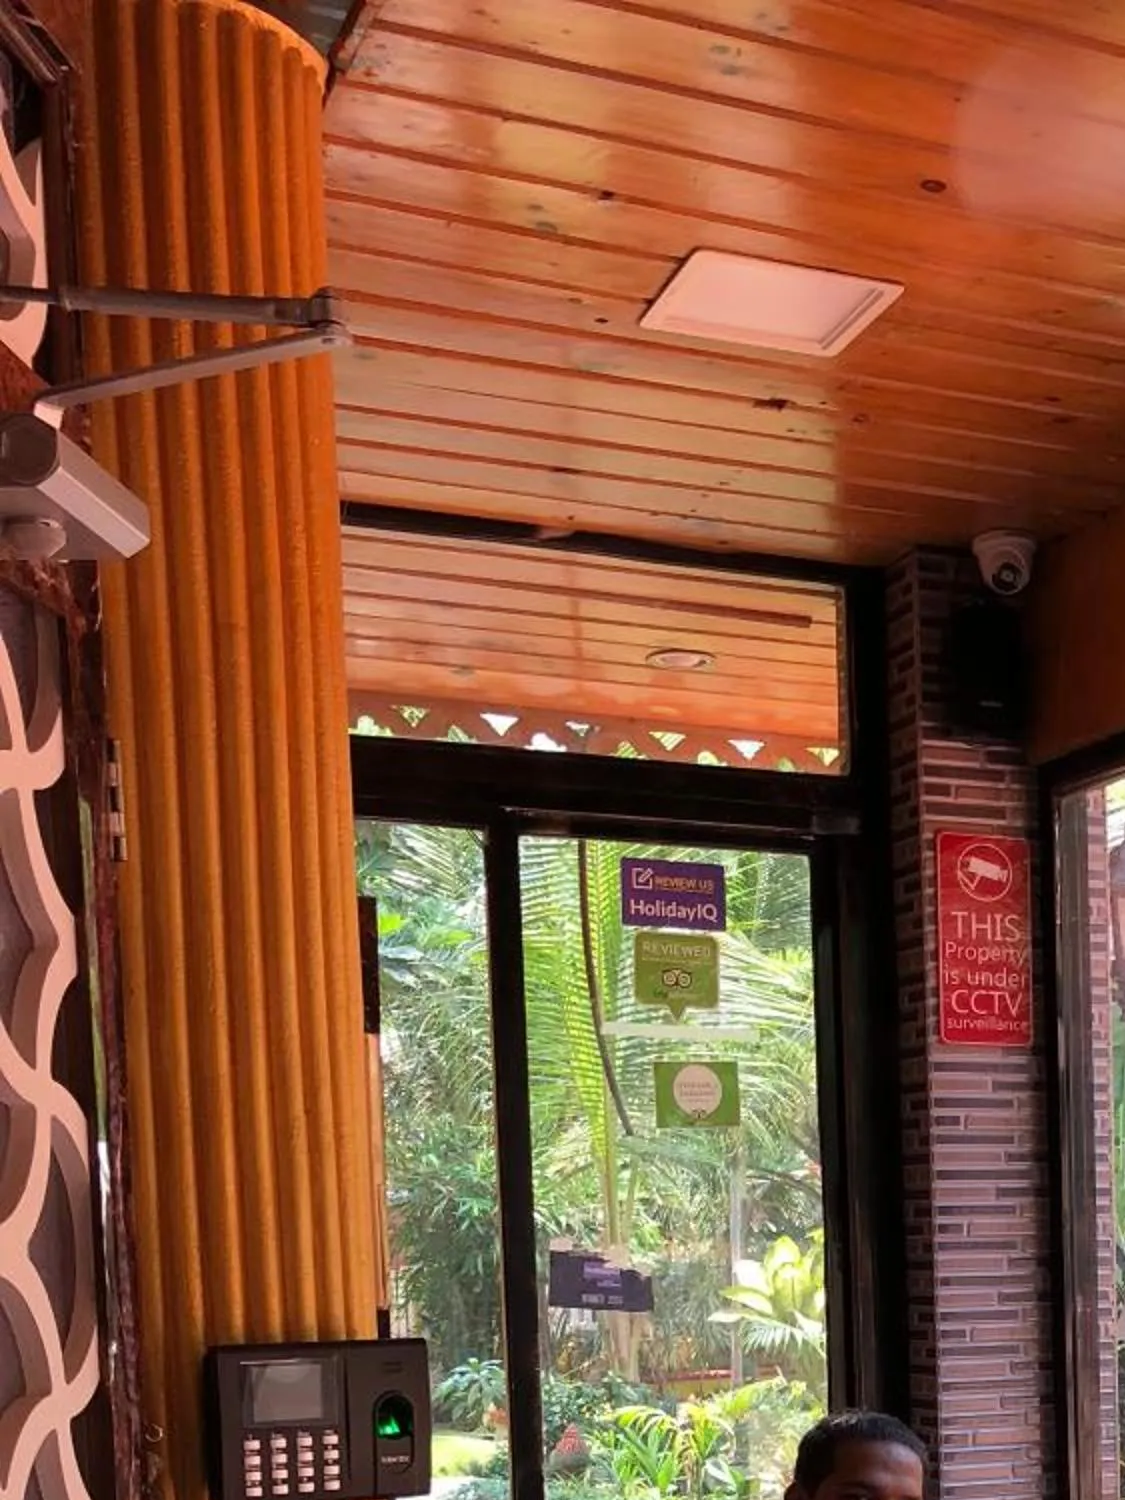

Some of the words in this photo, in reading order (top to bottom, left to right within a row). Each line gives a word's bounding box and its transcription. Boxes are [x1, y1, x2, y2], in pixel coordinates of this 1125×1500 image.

[654, 876, 697, 891] REVIEW
[630, 899, 718, 922] HolidayIQ
[951, 912, 1021, 941] THIS
[641, 940, 711, 958] REVIEWED
[945, 941, 1027, 967] Property
[944, 963, 959, 985] is
[967, 967, 1025, 988] under
[951, 989, 1022, 1017] CCTV
